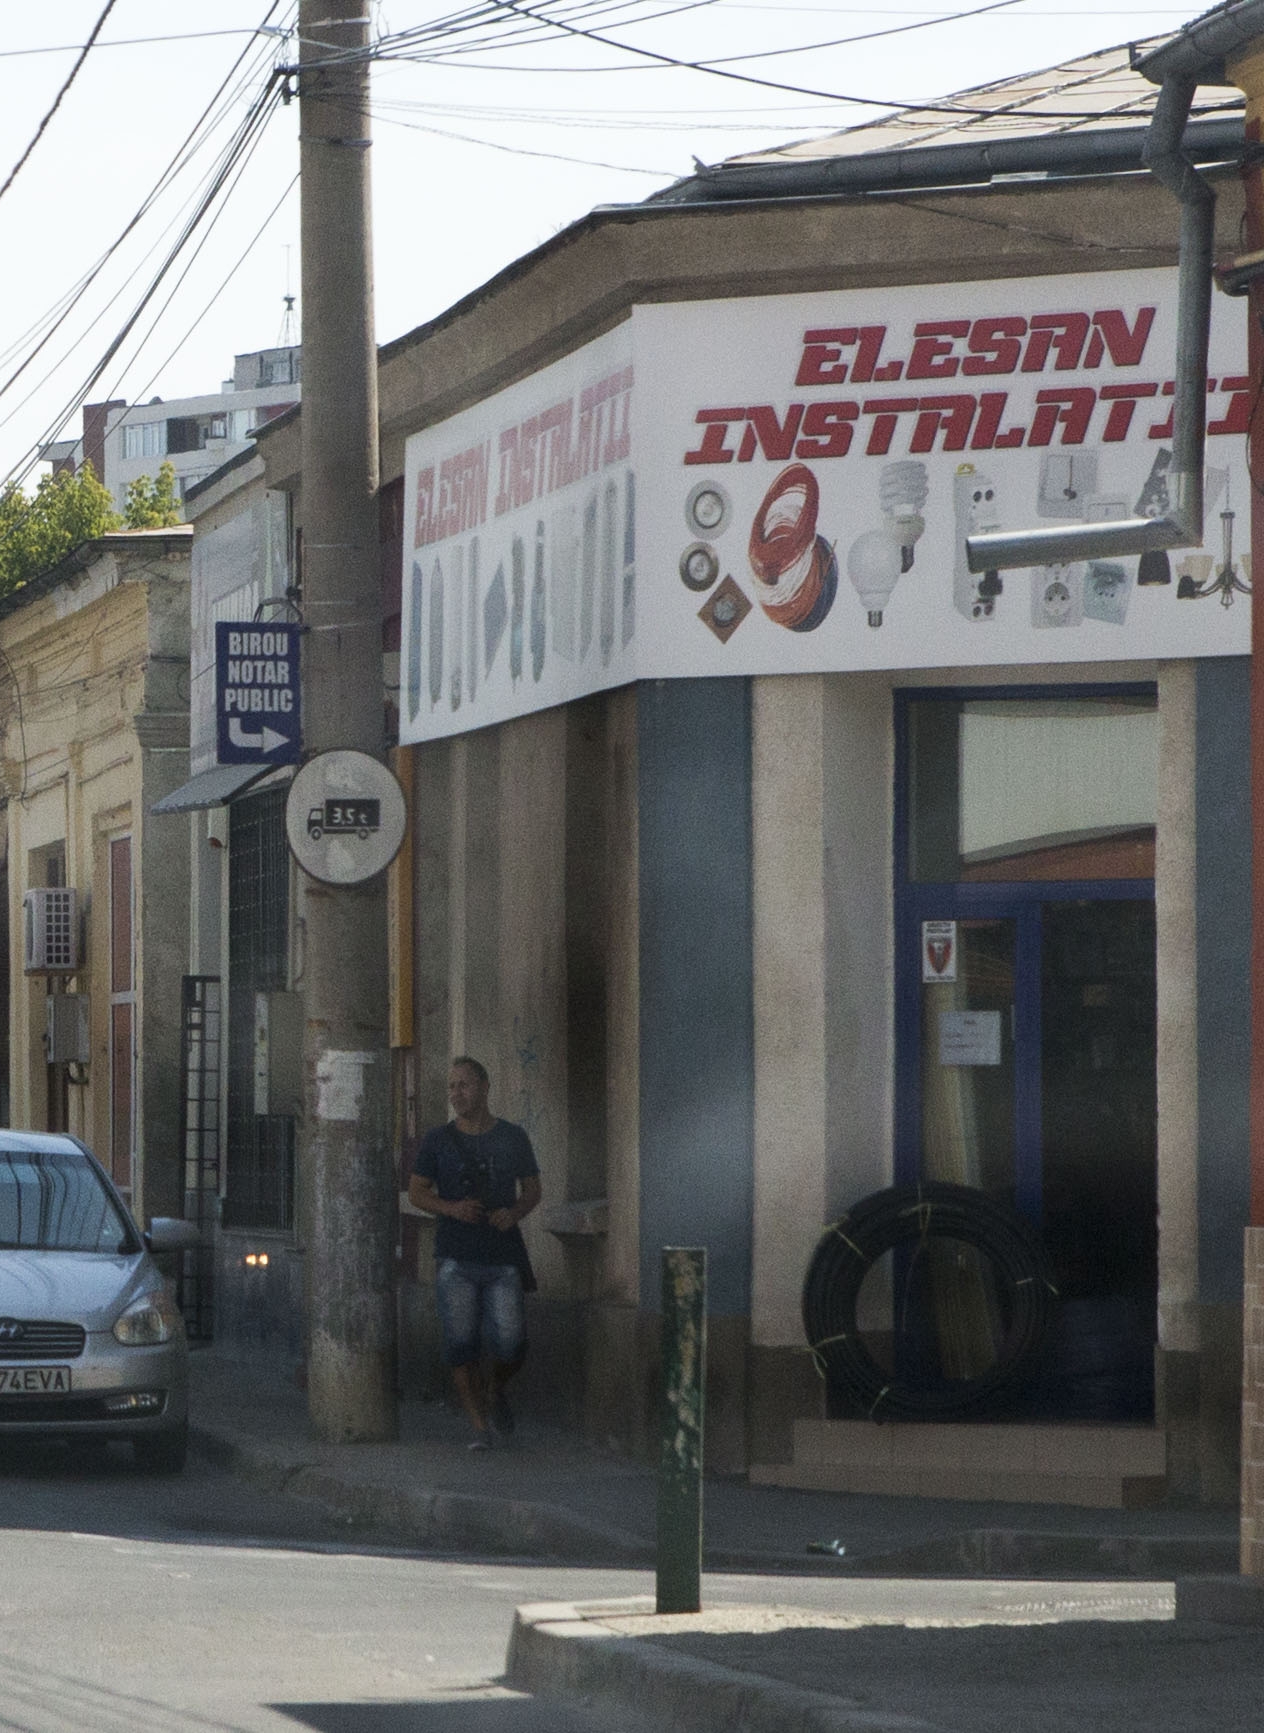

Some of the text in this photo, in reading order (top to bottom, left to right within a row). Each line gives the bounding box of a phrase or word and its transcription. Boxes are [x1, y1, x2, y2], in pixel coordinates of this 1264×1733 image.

[794, 307, 1156, 387] ELESAN
[228, 632, 289, 656] BIROU
[227, 660, 290, 684] NOTAR
[224, 688, 294, 713] PUBLIC
